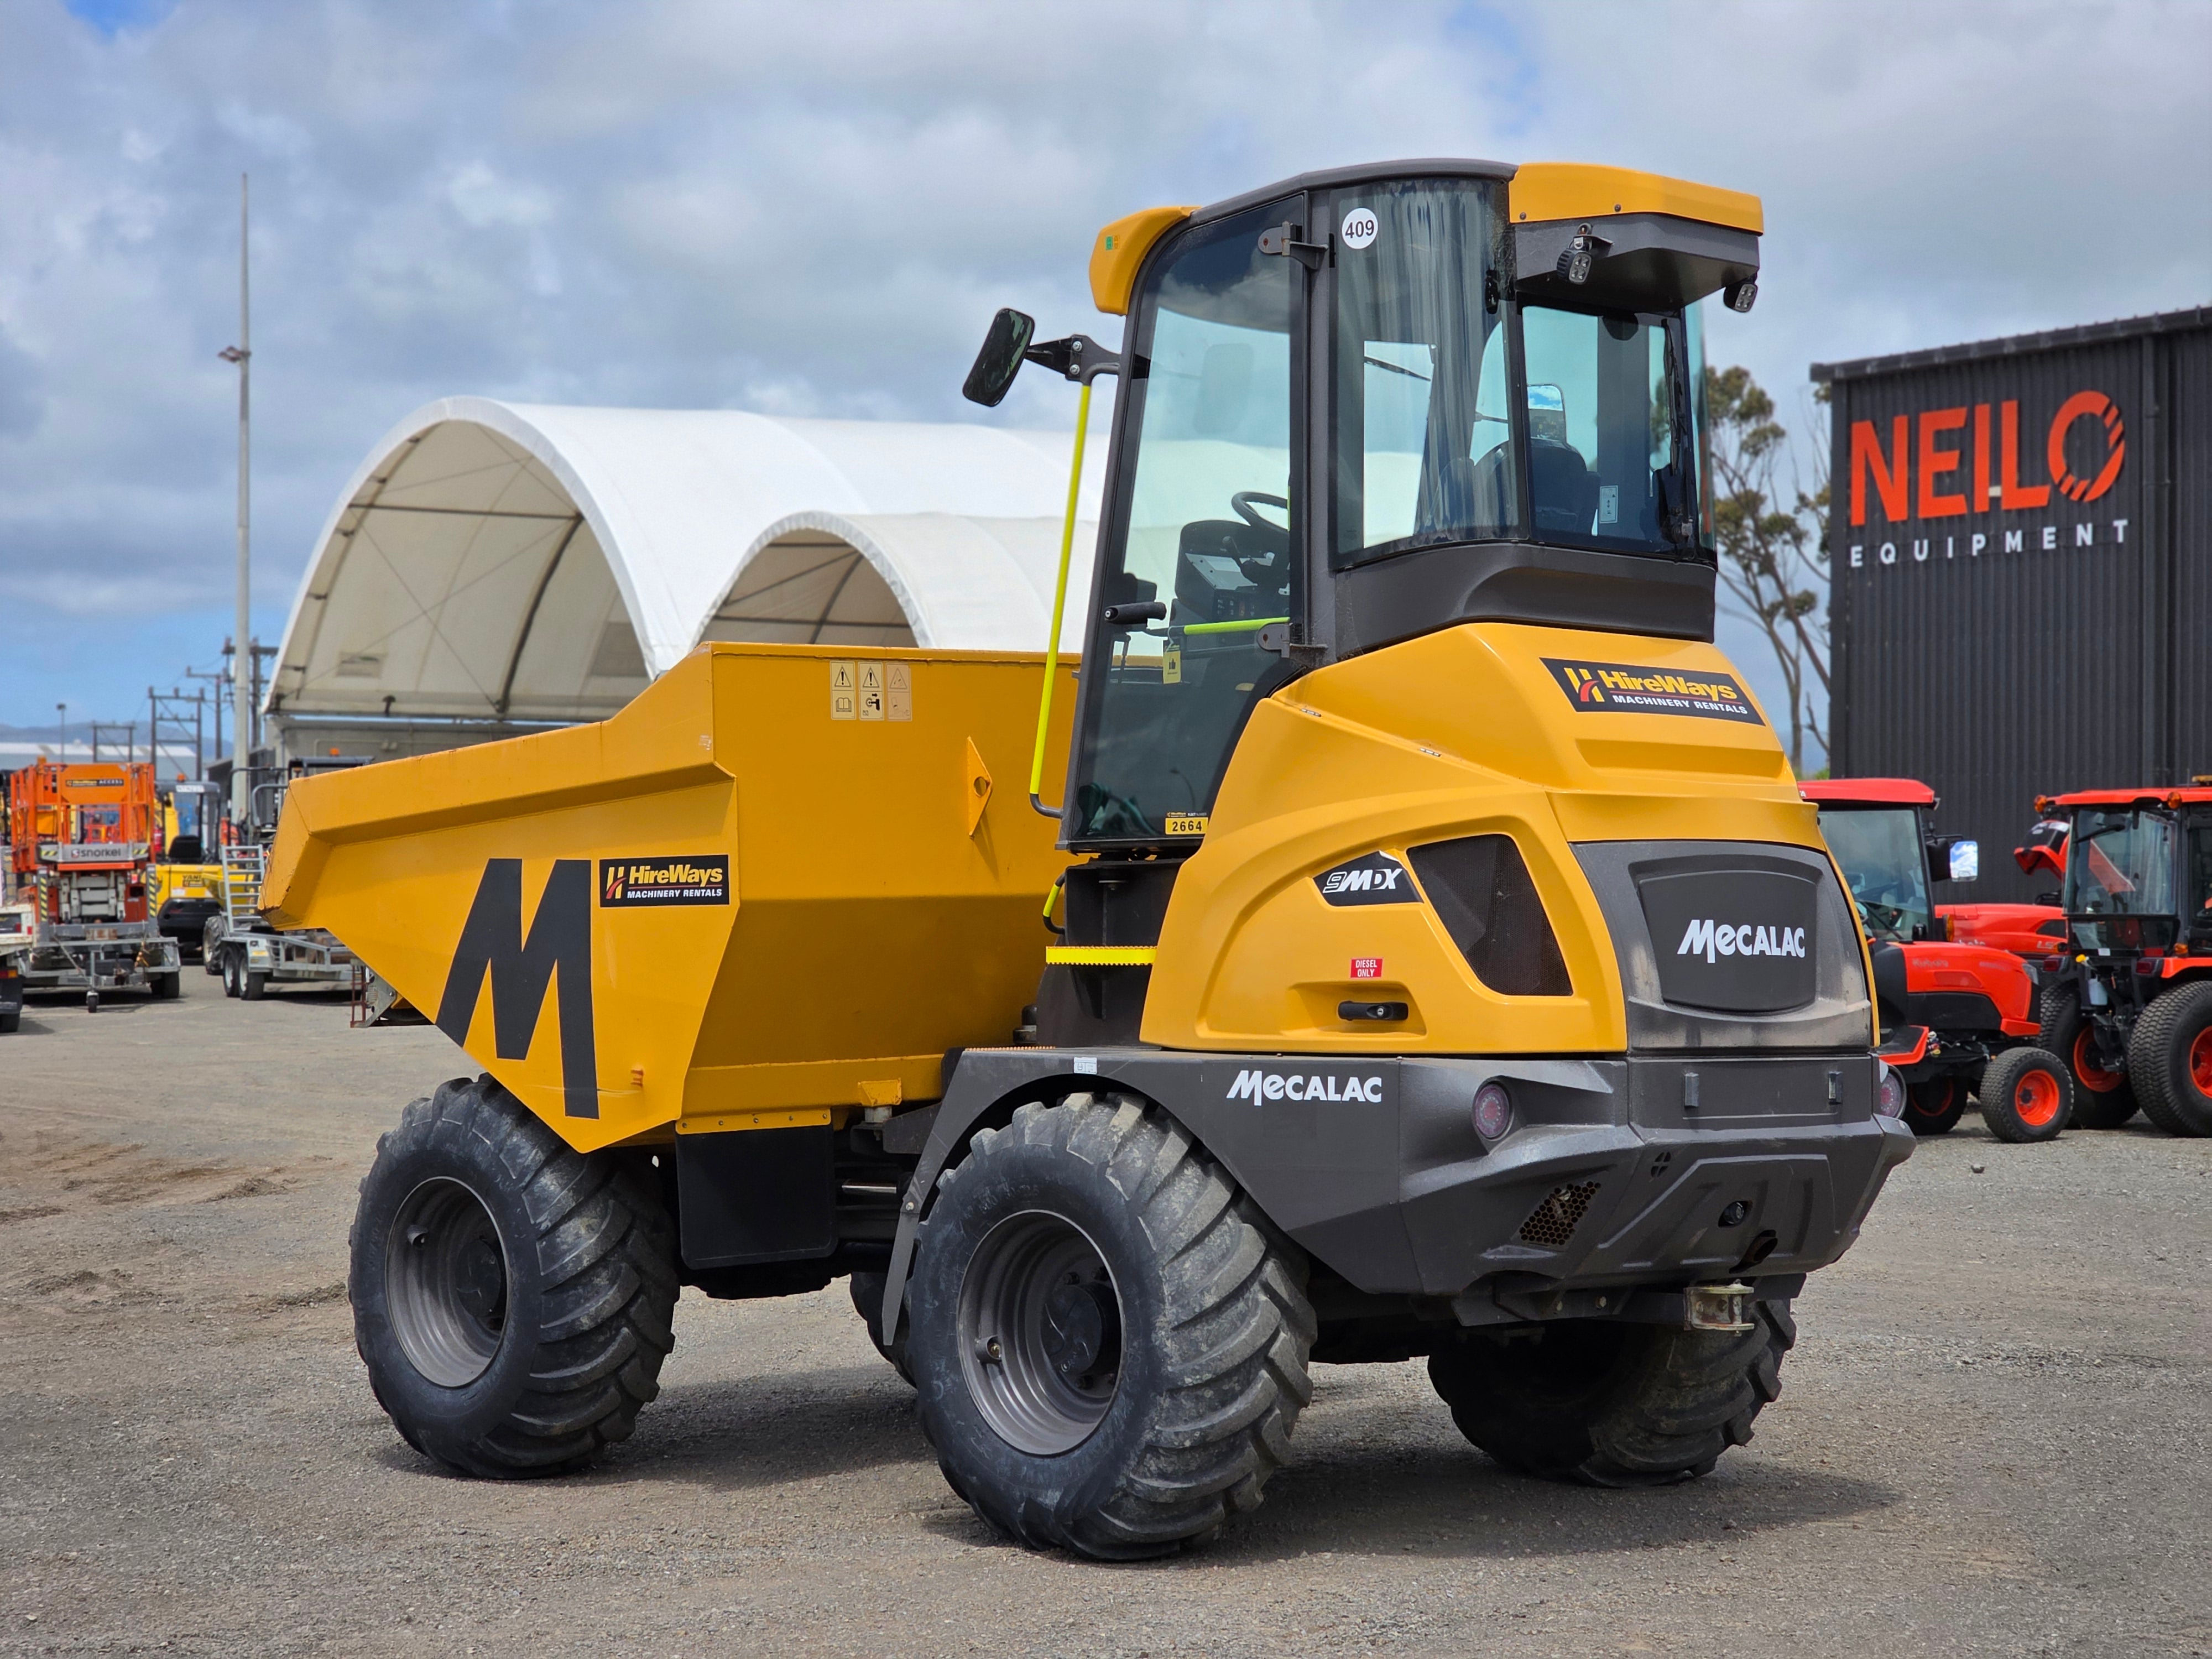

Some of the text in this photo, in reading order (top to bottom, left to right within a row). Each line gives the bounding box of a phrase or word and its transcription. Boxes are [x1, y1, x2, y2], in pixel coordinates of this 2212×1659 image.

[1345, 219, 1375, 239] 409
[1850, 390, 2125, 526] NEILO
[1850, 519, 2128, 567] EQUIPMENT
[1598, 669, 1738, 702] HireWays
[1612, 694, 1748, 715] MACHINERY RENTALS
[1172, 820, 1202, 832] 2664
[81, 848, 121, 857] snorkel
[628, 864, 723, 888] HireWays
[627, 888, 722, 899] MACHINERY RENTALS
[1355, 959, 1378, 968] DIESEL
[1357, 969, 1375, 978] ONLY
